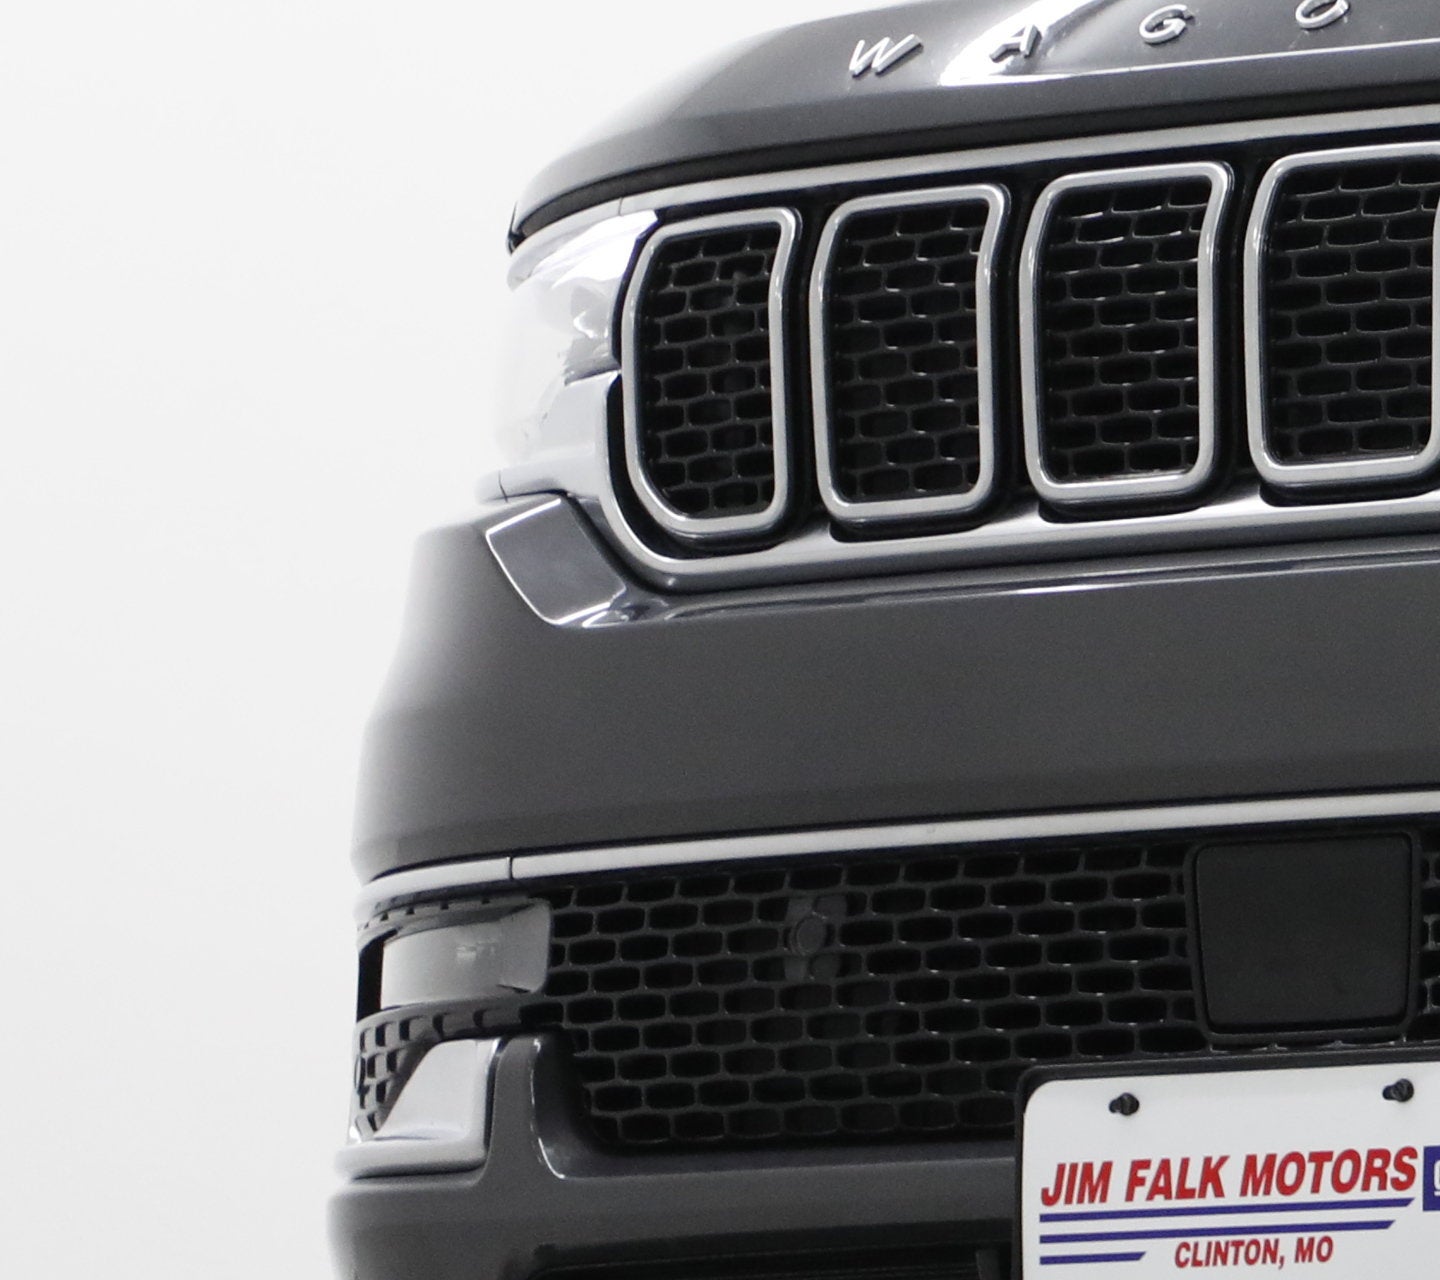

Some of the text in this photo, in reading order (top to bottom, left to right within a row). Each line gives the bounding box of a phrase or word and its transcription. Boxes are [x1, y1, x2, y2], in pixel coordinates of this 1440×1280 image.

[1041, 1146, 1418, 1207] JIM FALK MOTORS
[1175, 1235, 1334, 1269] CLINTON, MO
